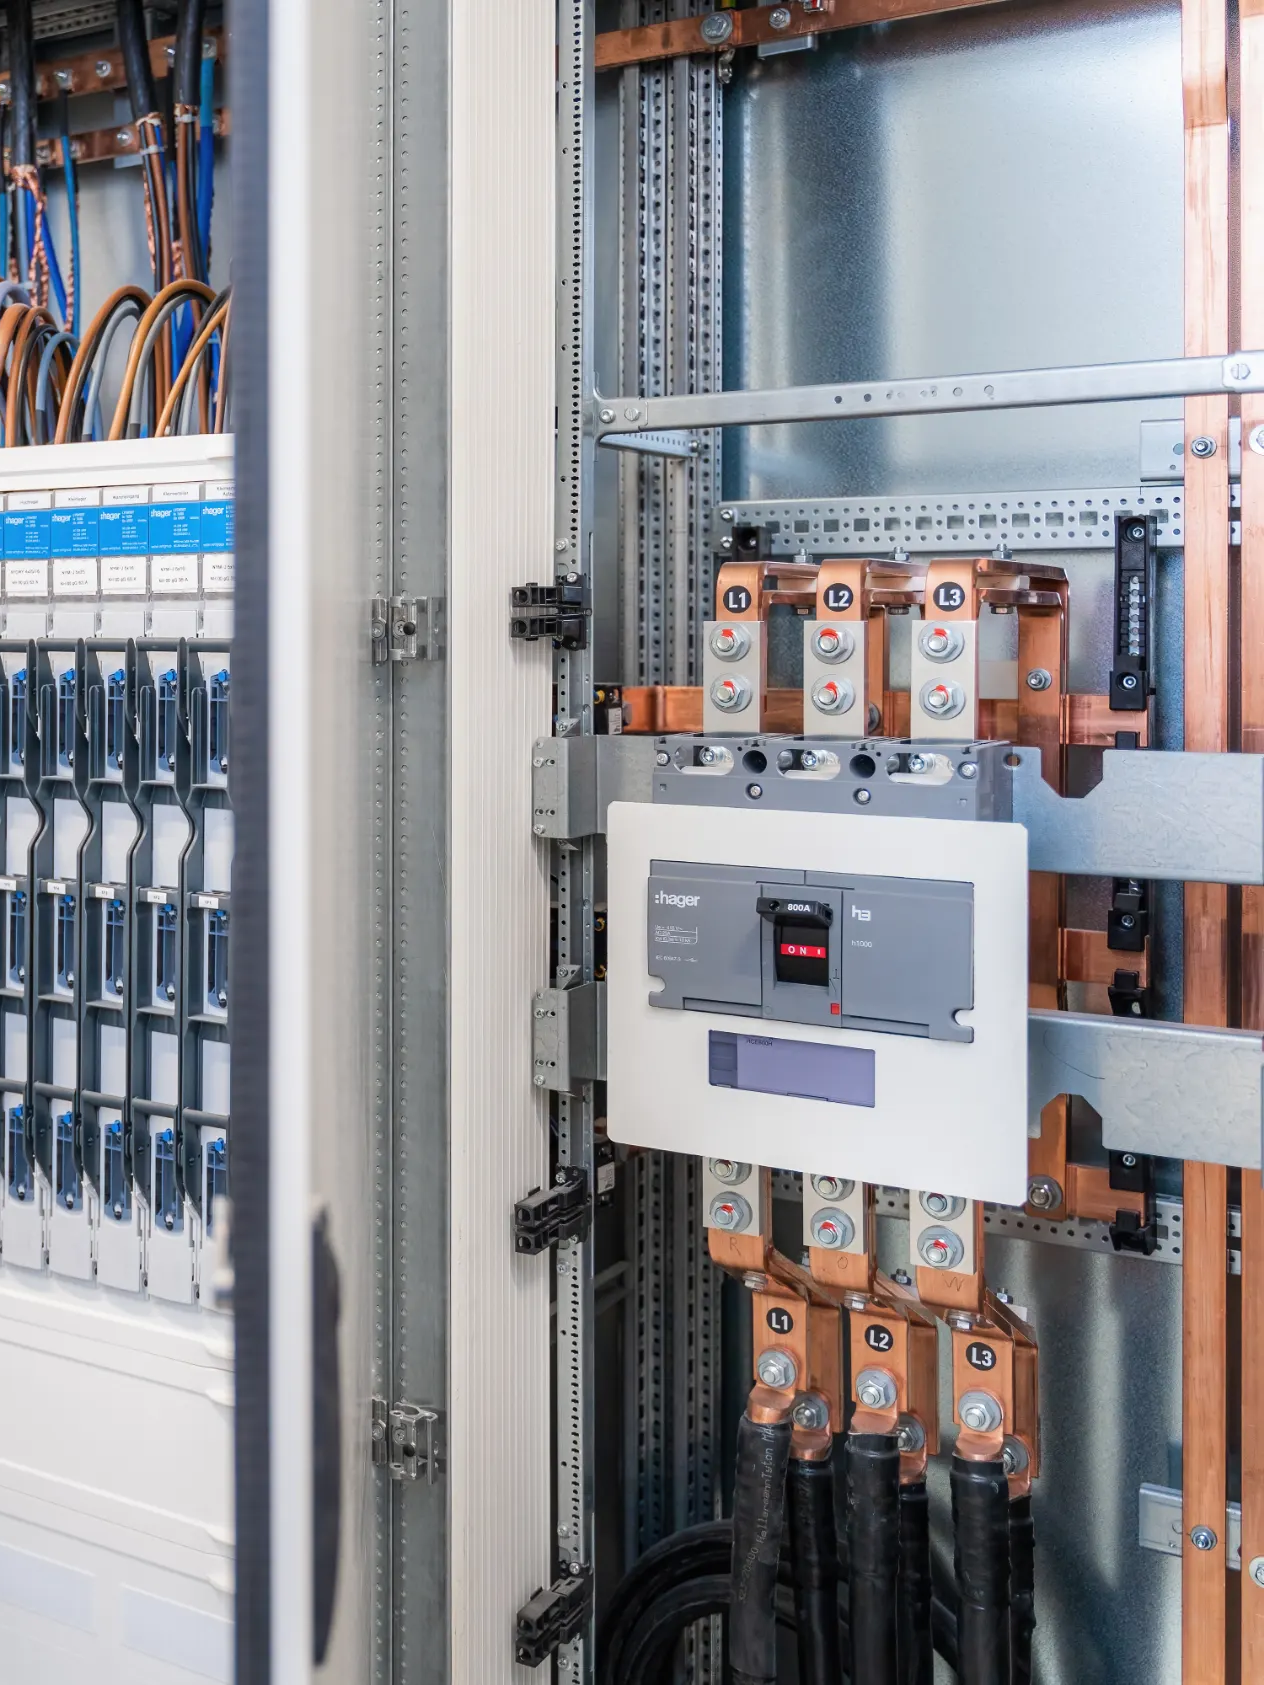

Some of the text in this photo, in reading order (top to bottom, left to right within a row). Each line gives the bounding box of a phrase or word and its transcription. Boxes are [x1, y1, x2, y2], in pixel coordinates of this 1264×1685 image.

[727, 592, 747, 609] L1
[828, 590, 850, 607] L2
[938, 588, 961, 606] L3
[787, 903, 811, 912] 800A
[787, 945, 807, 955] ON
[944, 1276, 965, 1292] W
[771, 1312, 790, 1330] L1
[869, 1329, 889, 1349] L2
[970, 1347, 992, 1366] L3
